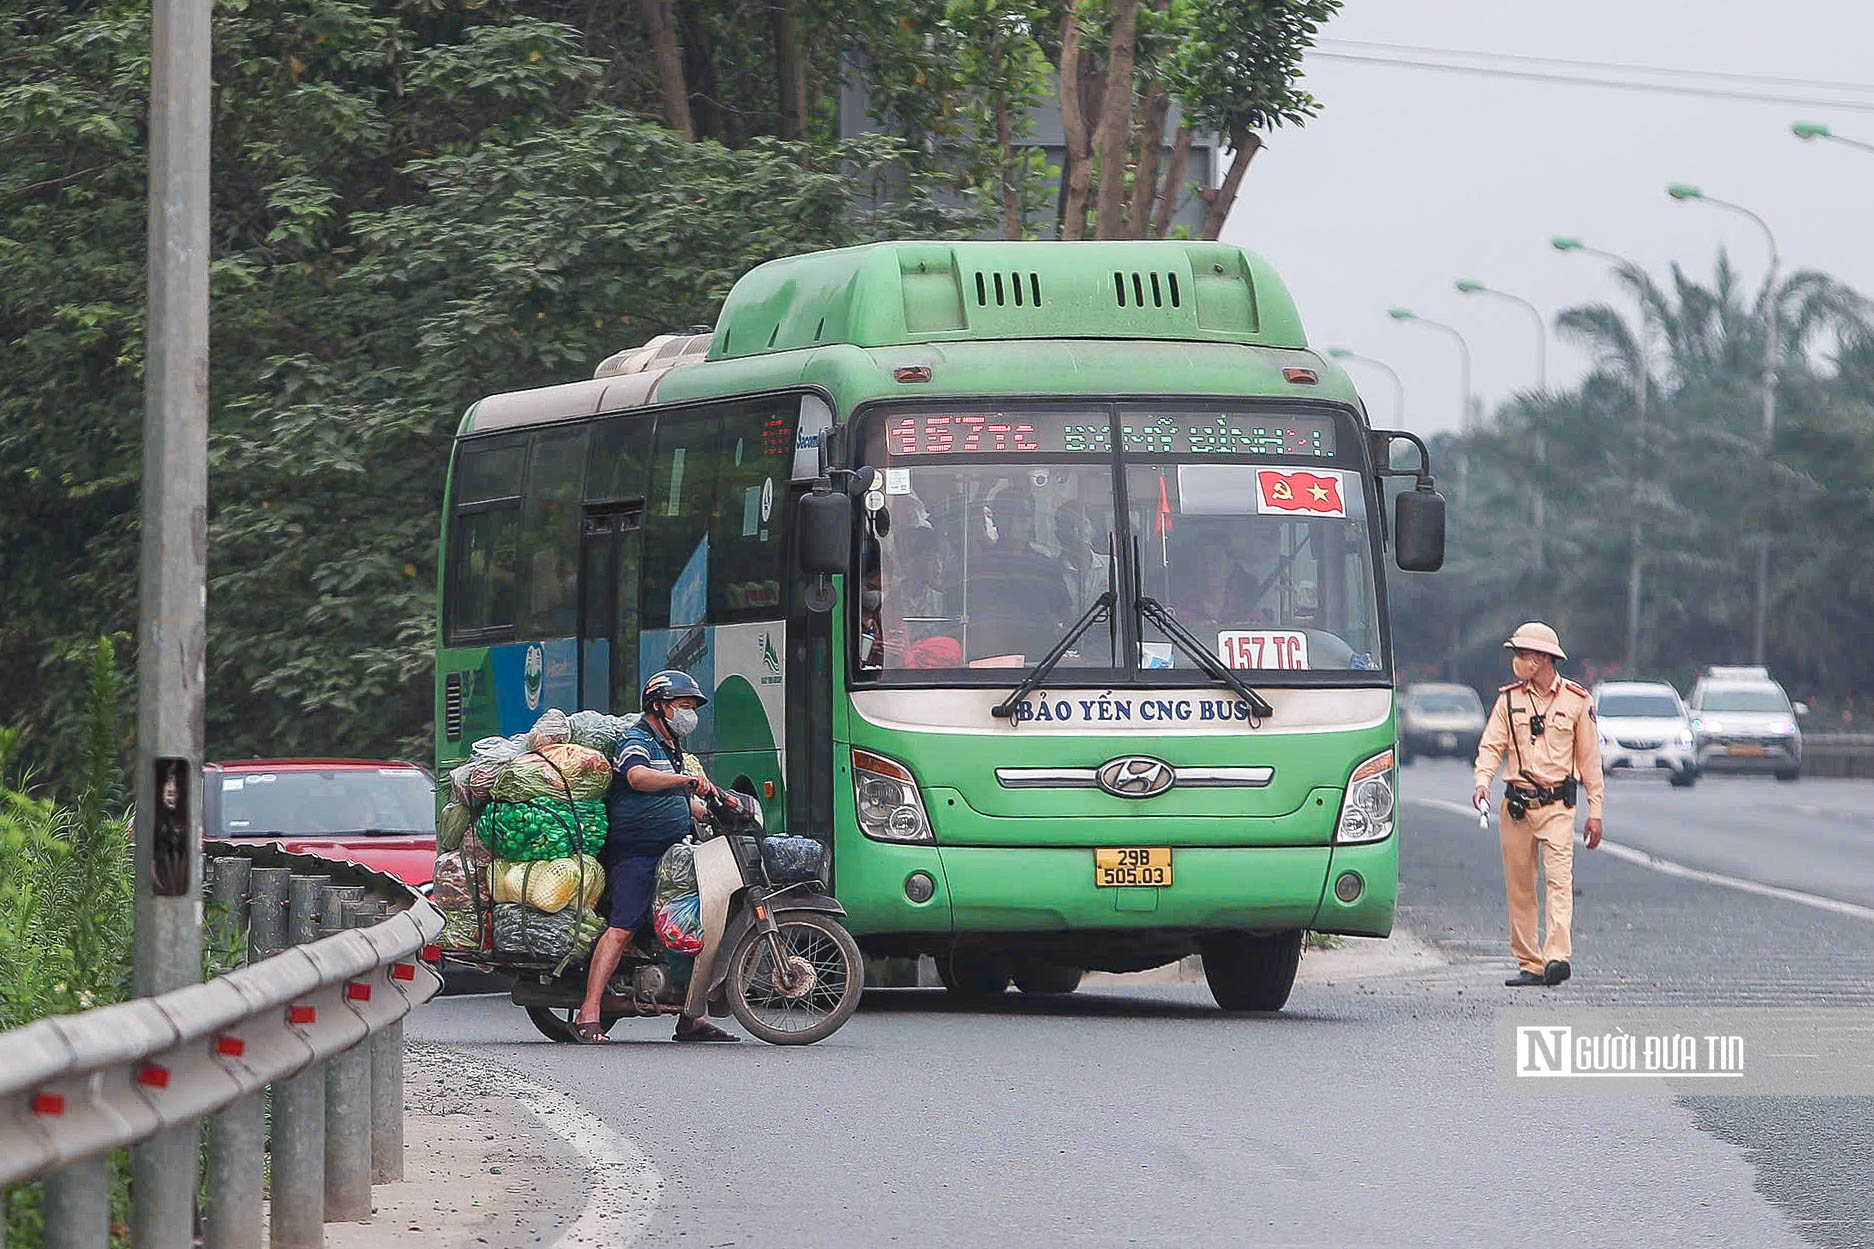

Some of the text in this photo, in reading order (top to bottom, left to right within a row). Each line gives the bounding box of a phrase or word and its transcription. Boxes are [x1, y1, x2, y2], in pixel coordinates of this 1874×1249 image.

[1224, 636, 1302, 671] 157 TC
[1018, 689, 1249, 722] BẢO YẾN CNG BUS
[1117, 850, 1150, 866] 29B
[1104, 867, 1164, 885] 505.03
